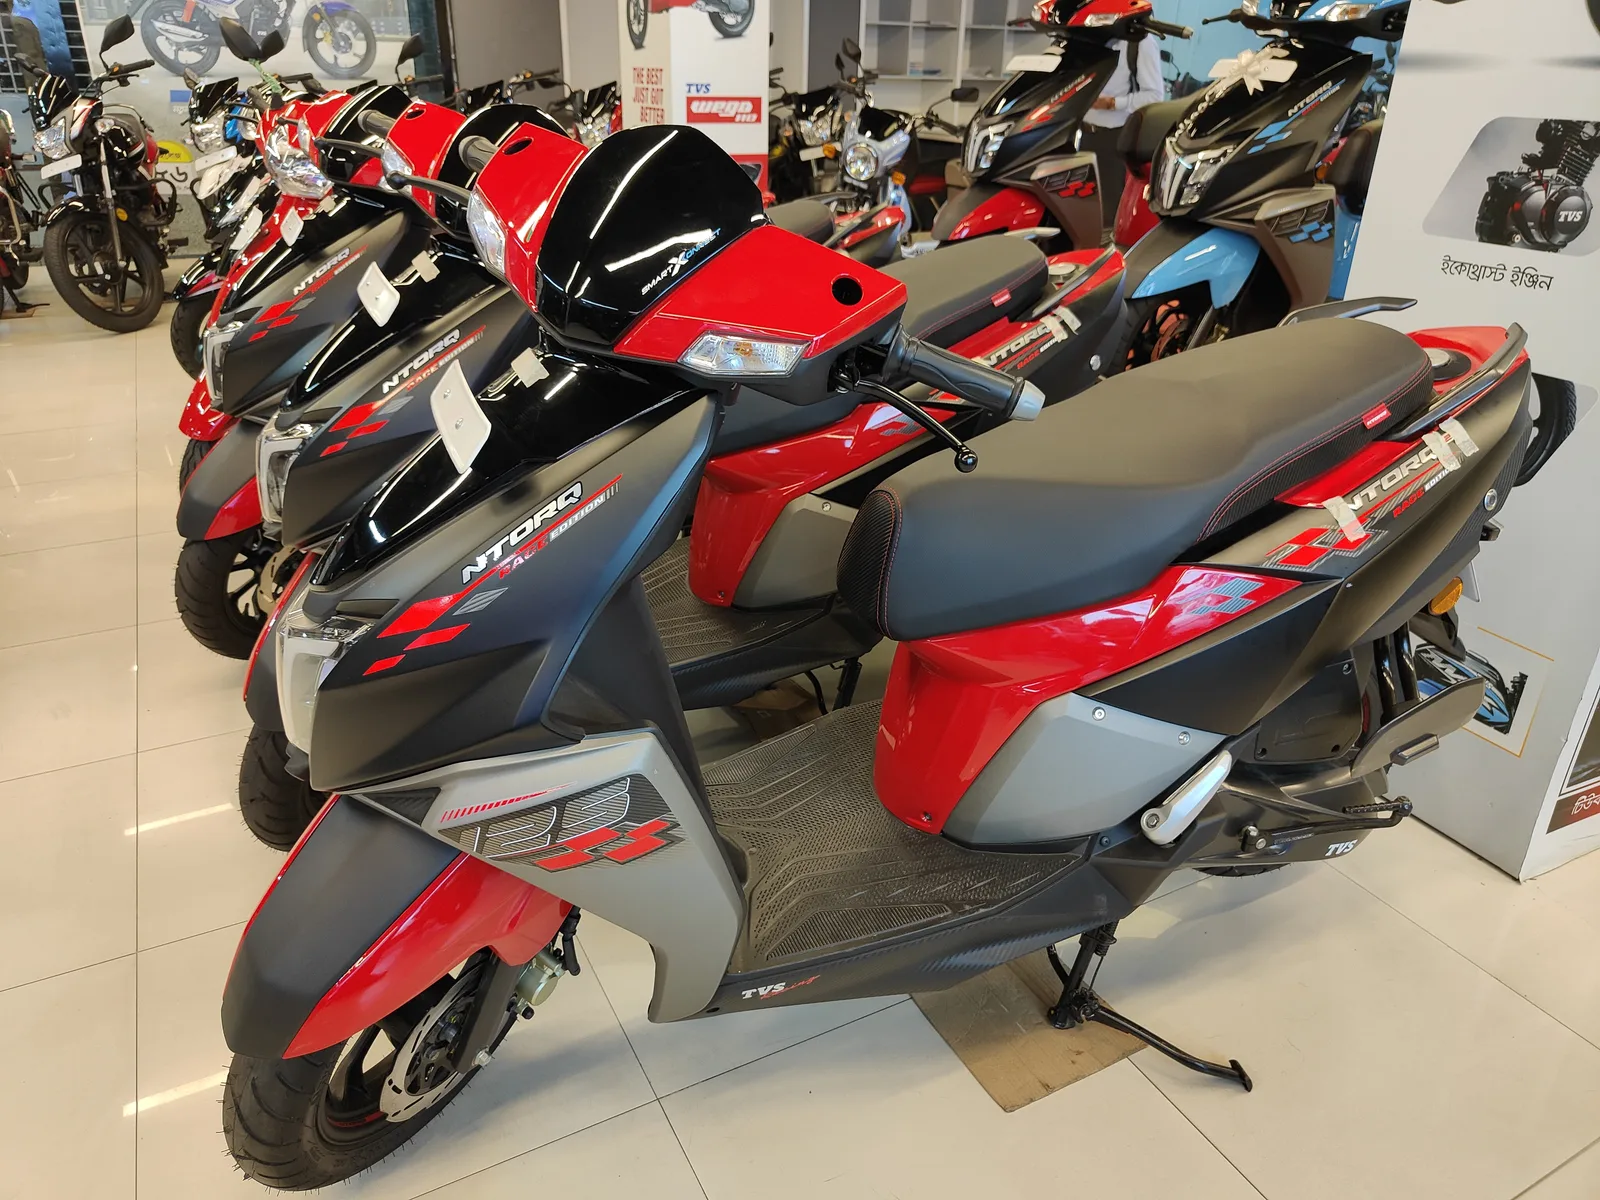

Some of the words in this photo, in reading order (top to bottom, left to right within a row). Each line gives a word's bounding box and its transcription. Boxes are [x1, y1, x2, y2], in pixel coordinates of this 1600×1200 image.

[686, 83, 711, 94] TVS
[1287, 80, 1333, 117] NTORQ
[640, 106, 665, 124] BETTER
[690, 100, 753, 118] wego
[1558, 210, 1584, 223] TVS
[1441, 254, 1508, 282] ইকোথ্রাস্ট
[1509, 265, 1555, 291] ইঞ্জিন
[382, 328, 460, 394] NTORQ
[1393, 486, 1425, 518] RACE
[461, 480, 584, 585] NTORQ
[499, 534, 550, 580] RACE
[550, 494, 606, 543] EDITION
[1324, 839, 1359, 857] TVS
[741, 982, 786, 1000] TVS
